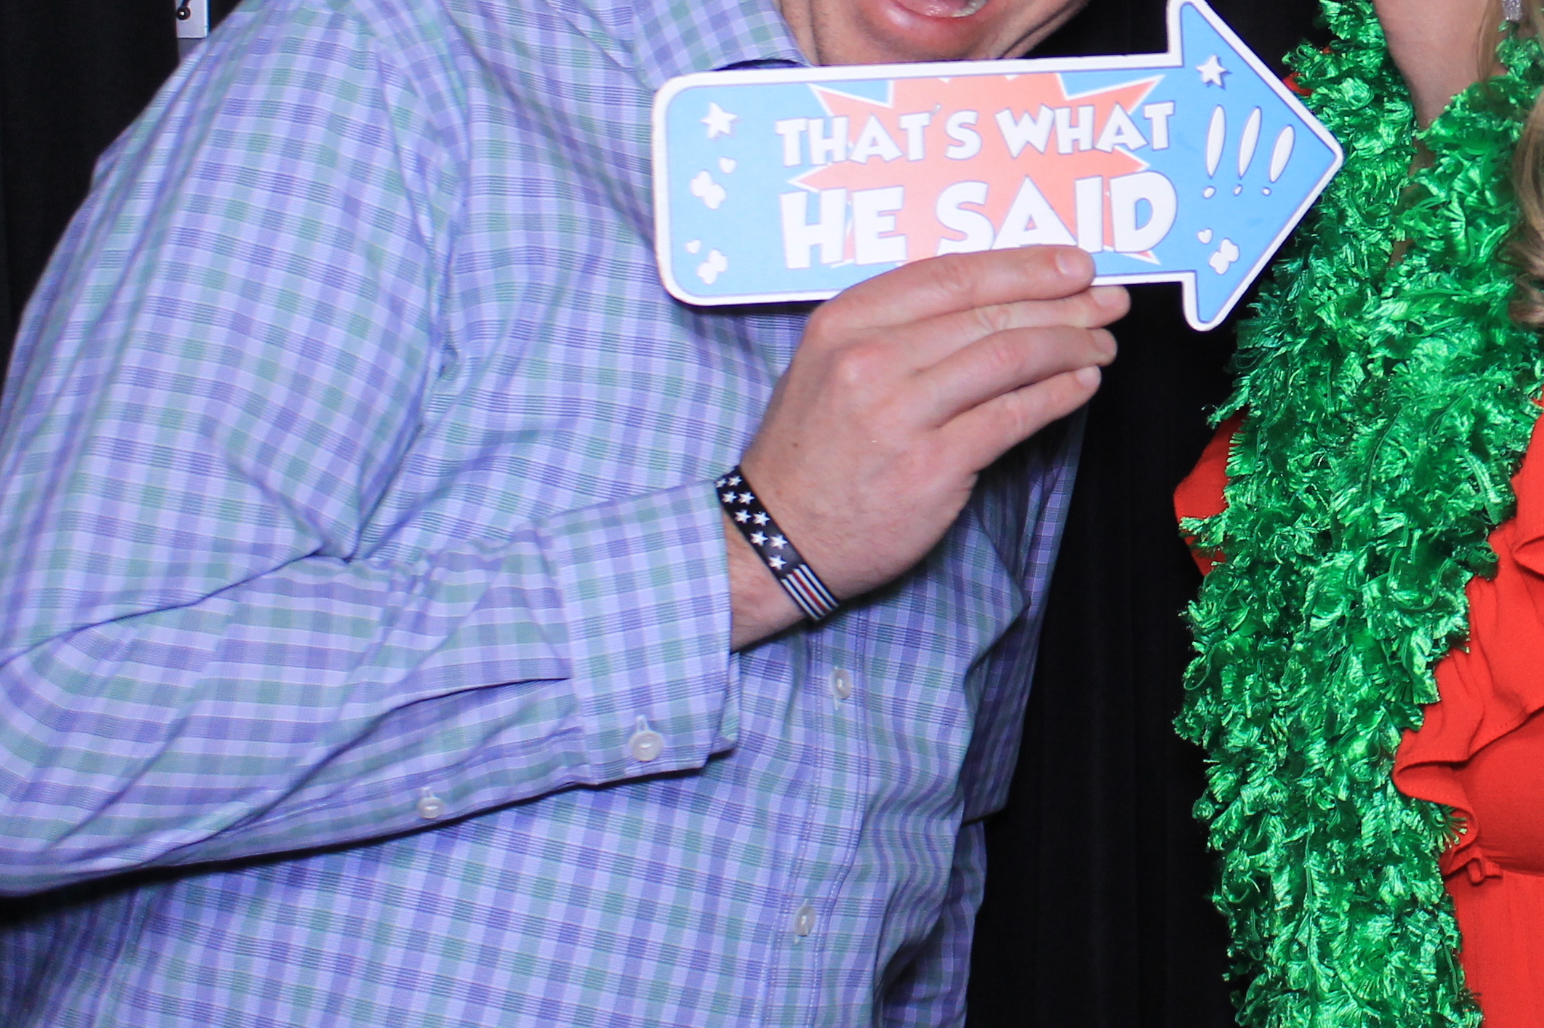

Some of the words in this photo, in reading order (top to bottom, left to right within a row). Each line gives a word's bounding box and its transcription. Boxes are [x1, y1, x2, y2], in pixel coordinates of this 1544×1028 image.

[775, 103, 981, 167] THAT'S
[995, 101, 1174, 158] WHAT
[780, 186, 907, 269] HE
[936, 171, 1177, 256] SAID
